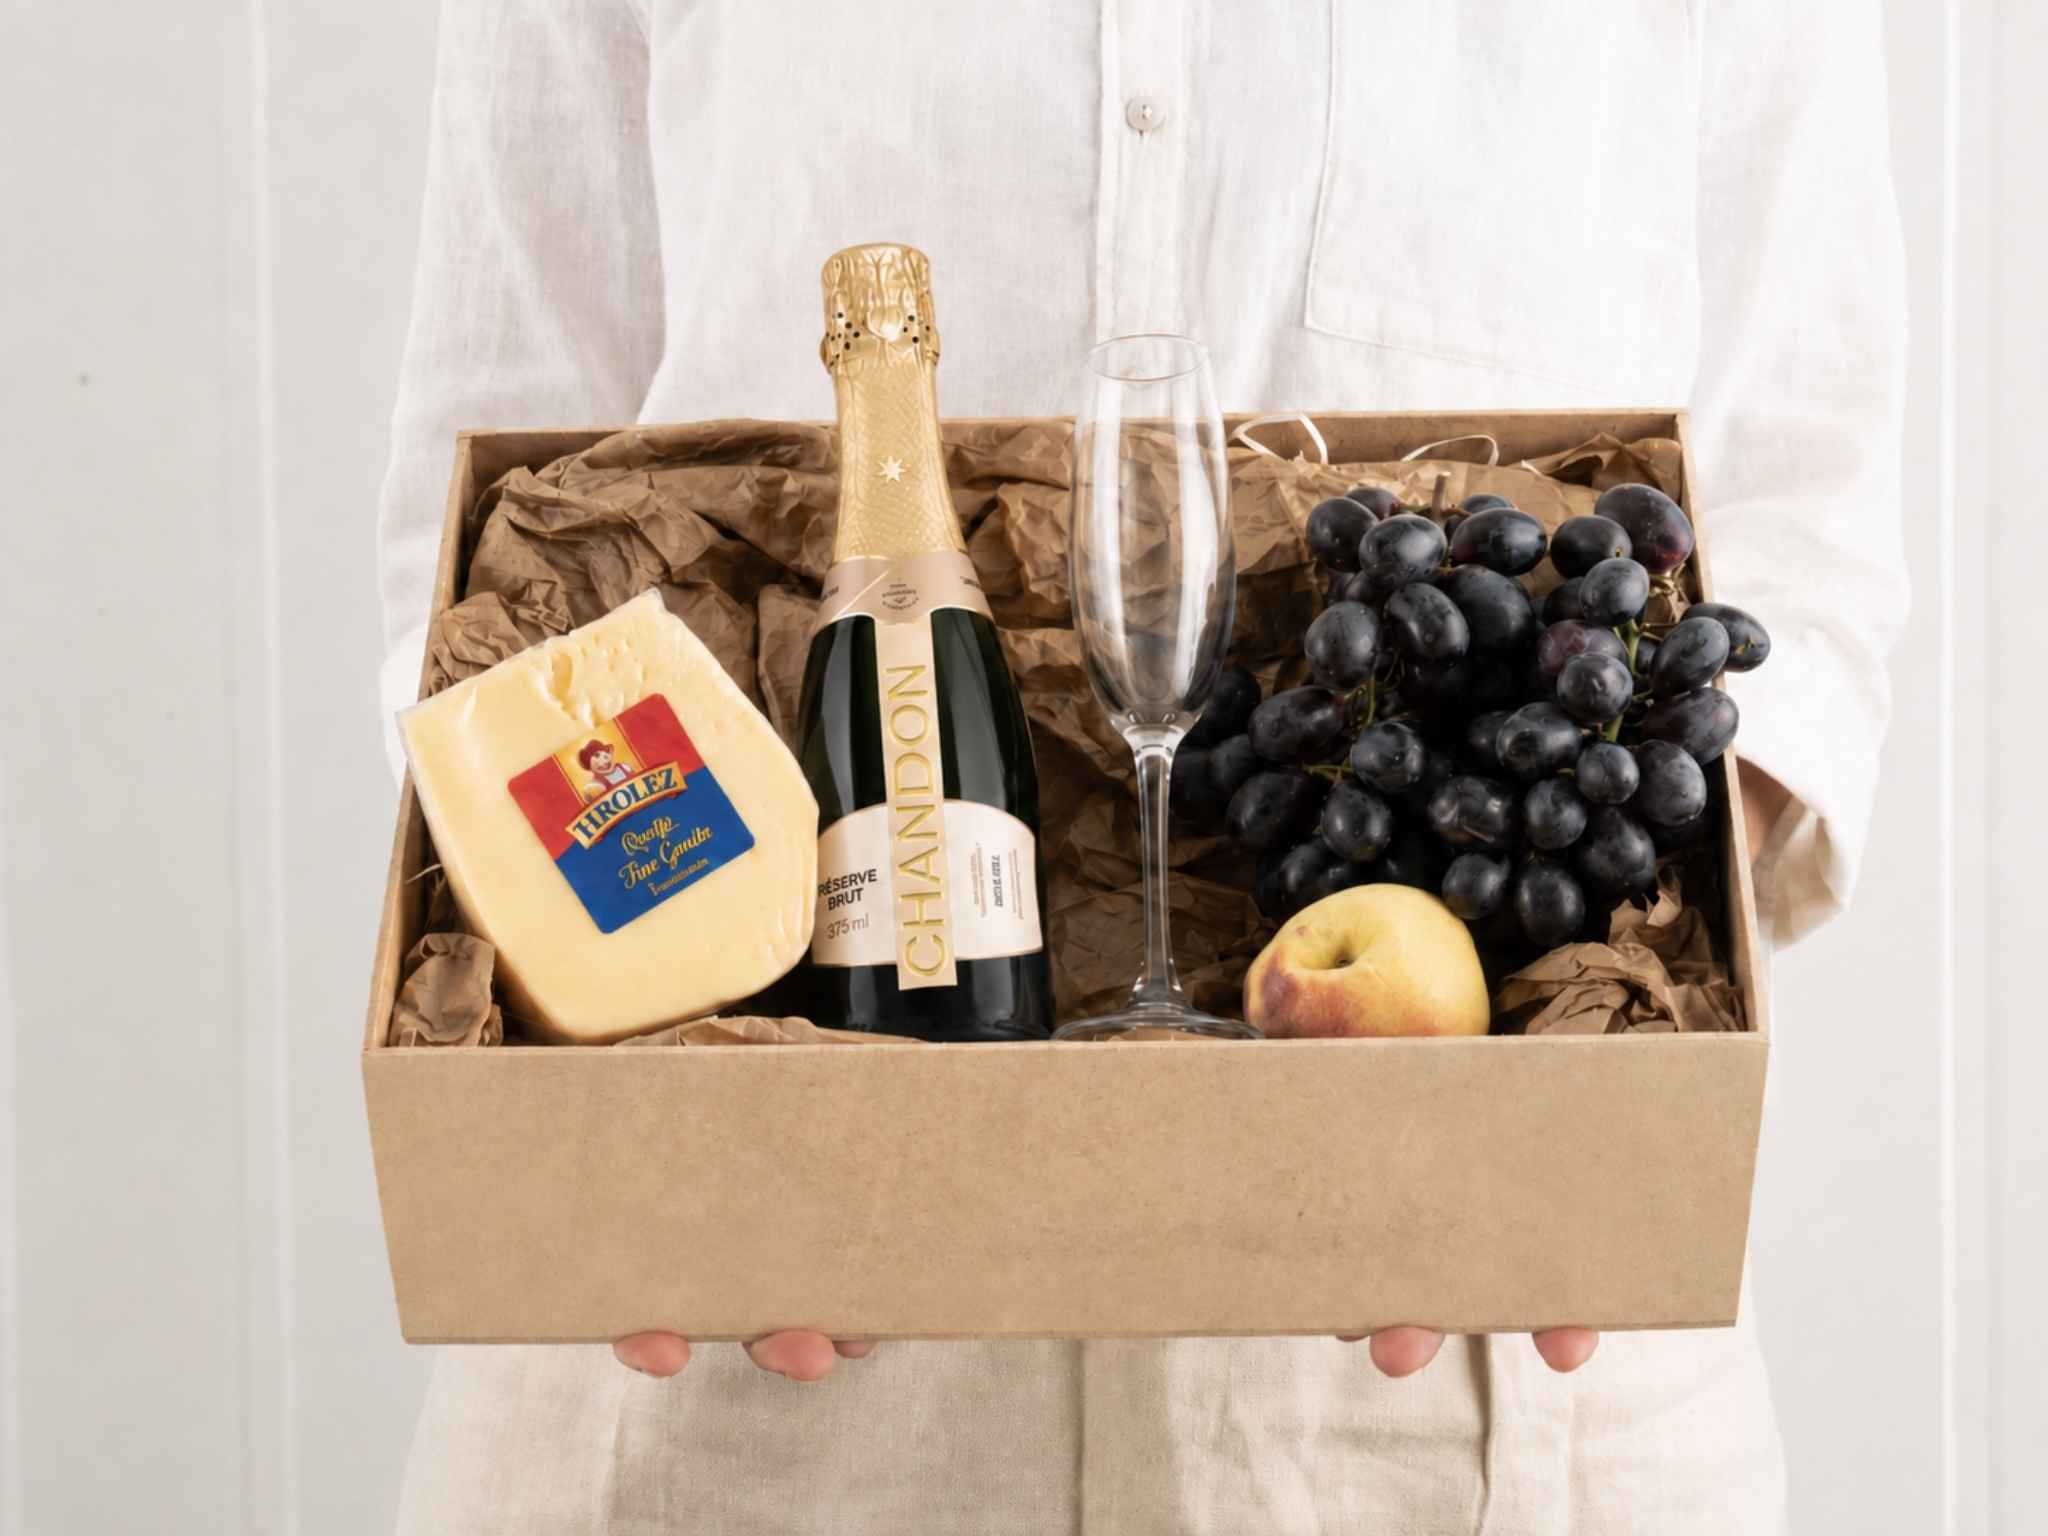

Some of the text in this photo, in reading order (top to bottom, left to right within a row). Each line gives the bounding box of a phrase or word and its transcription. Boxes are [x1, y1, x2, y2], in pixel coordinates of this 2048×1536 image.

[886, 664, 945, 977] CHANDON
[817, 868, 877, 897] RÉSERVE
[827, 888, 864, 911] BRUT
[827, 913, 869, 940] 375 ml
